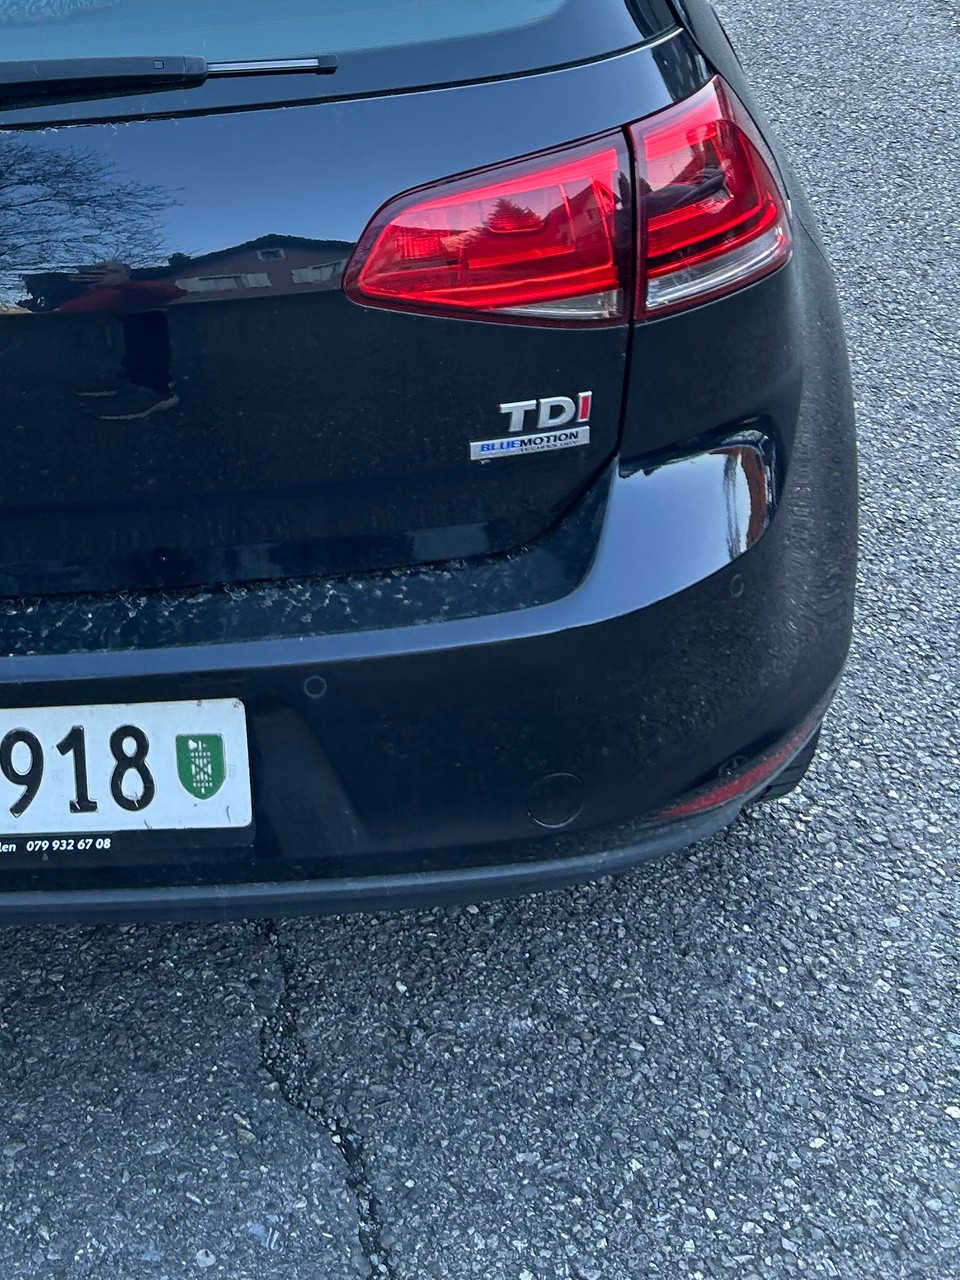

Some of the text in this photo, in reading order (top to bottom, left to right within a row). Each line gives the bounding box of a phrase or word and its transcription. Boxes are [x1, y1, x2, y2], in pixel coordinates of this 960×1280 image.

[499, 390, 592, 432] TDI
[479, 430, 580, 453] BLUEMOTION
[26, 840, 50, 852] 079
[51, 838, 75, 851] 932
[77, 838, 94, 850] 67
[95, 837, 112, 850] 08
